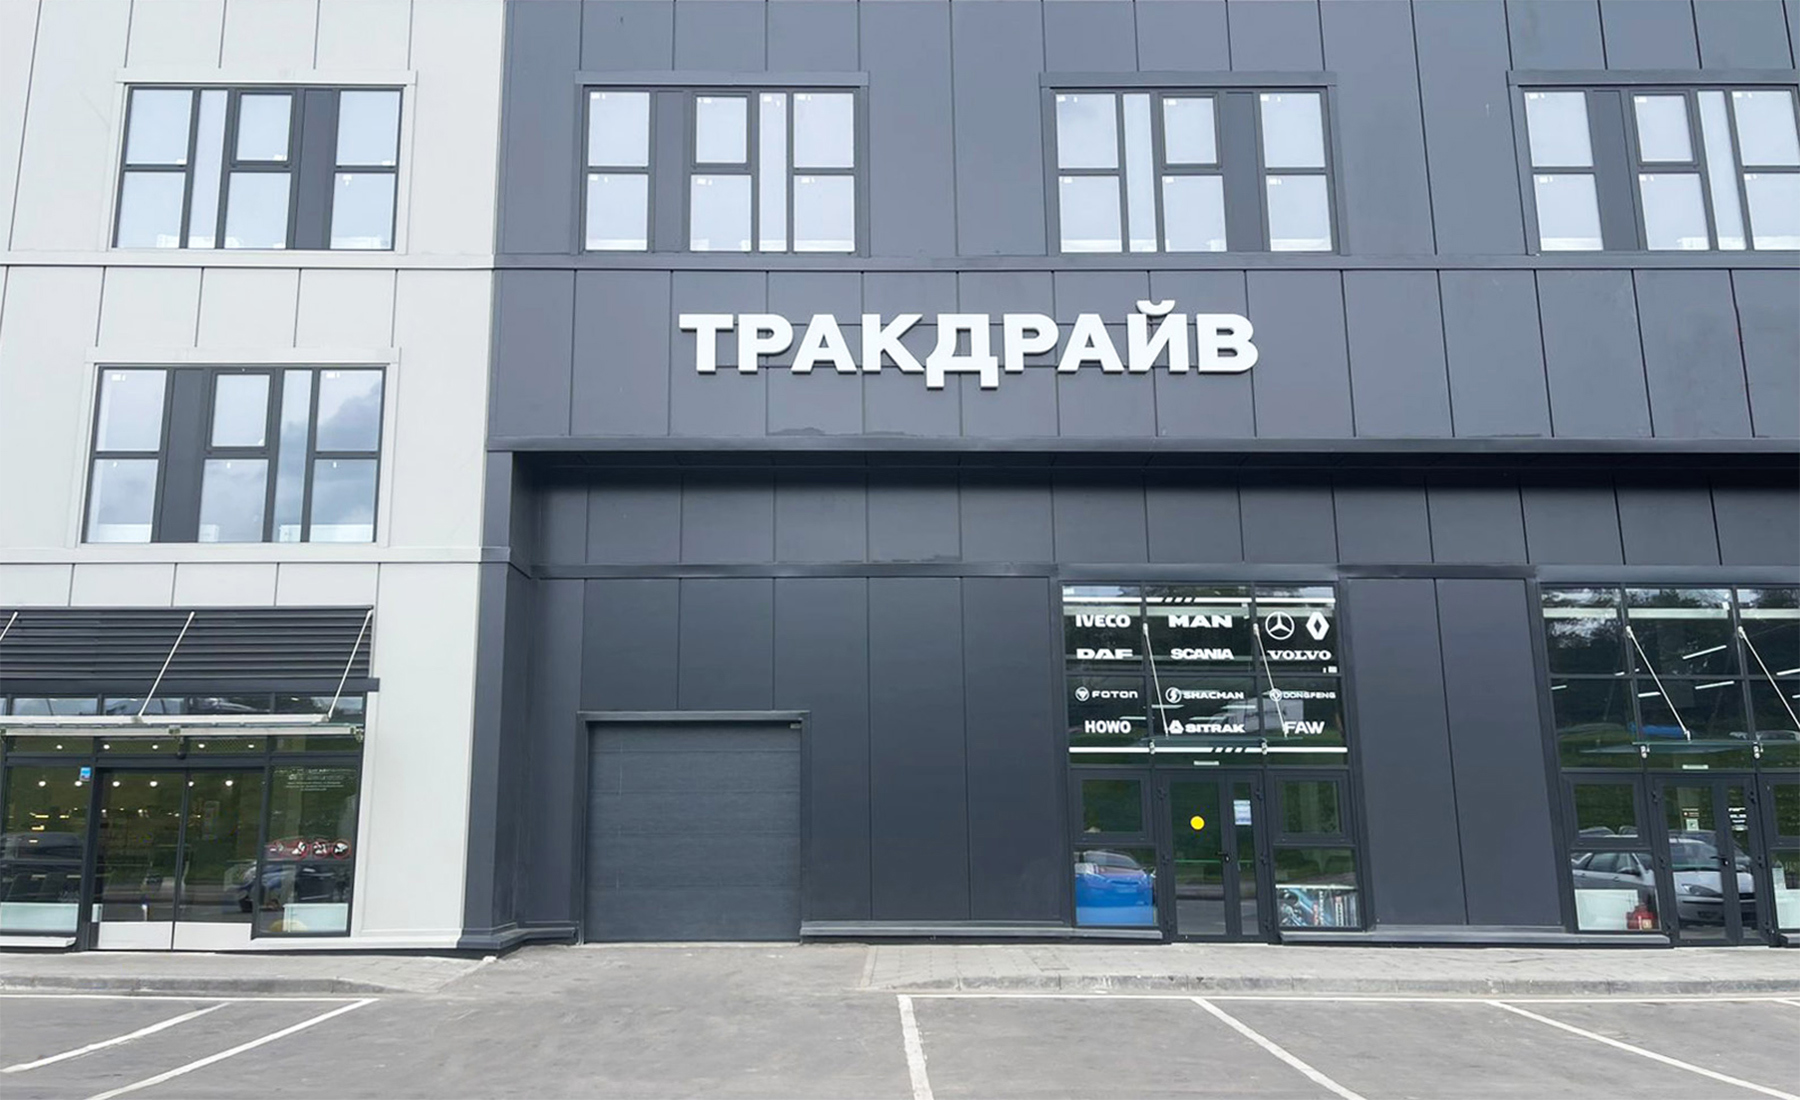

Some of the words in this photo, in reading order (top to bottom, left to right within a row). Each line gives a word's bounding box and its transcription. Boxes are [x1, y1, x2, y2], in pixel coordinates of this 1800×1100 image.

[679, 300, 1260, 389] ТРАКДРАЙВ
[1075, 613, 1131, 628] IVECO
[1168, 614, 1233, 628] MAN
[1076, 648, 1133, 660] DAF
[1170, 647, 1235, 661] SCANIA
[1267, 649, 1332, 661] VOLVO
[1183, 690, 1244, 700] SHACMAN
[1283, 691, 1336, 700] DONGFENG
[1084, 719, 1131, 734] HOWO
[1185, 722, 1245, 734] SITRAK
[1286, 721, 1325, 734] FAW
